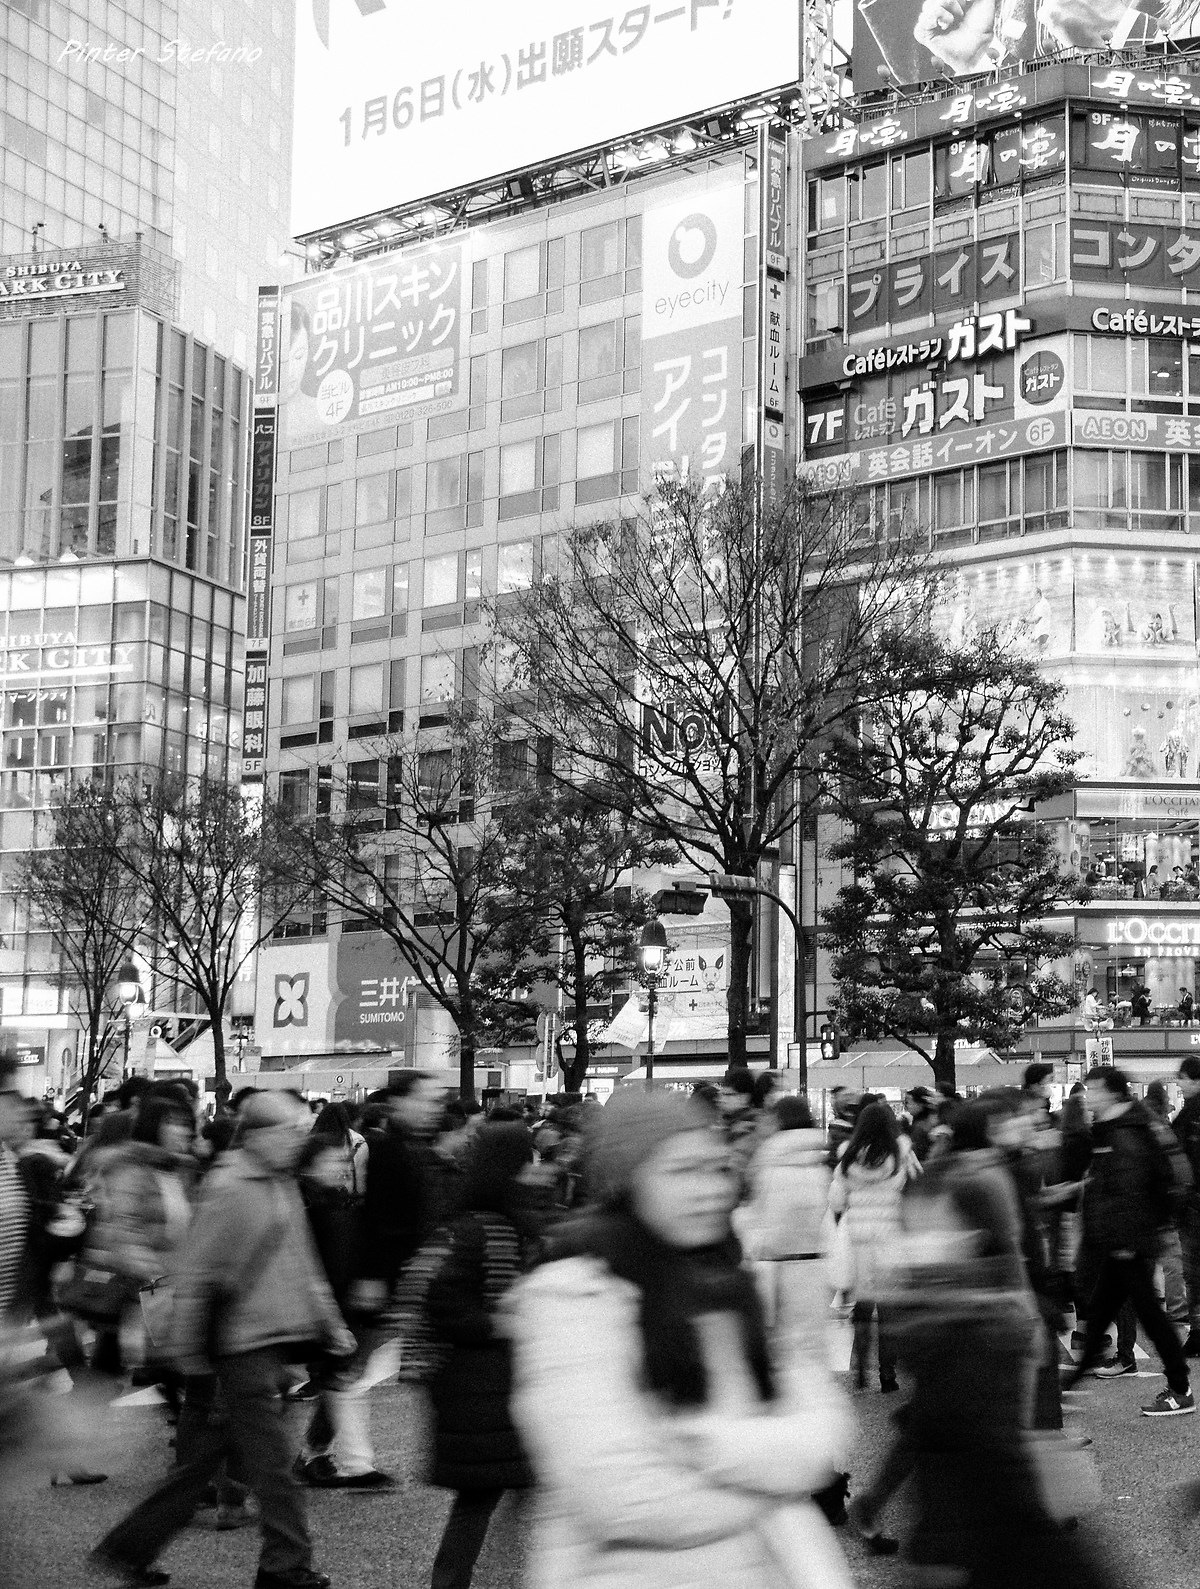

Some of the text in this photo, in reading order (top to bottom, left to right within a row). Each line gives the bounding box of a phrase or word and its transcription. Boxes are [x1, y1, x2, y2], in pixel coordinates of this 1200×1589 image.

[1092, 113, 1111, 125] 9F
[950, 141, 966, 155] 9F
[6, 261, 82, 278] SHIBUYA
[770, 254, 781, 265] 9F
[54, 269, 123, 291] CITY
[850, 244, 1020, 318] プライス
[313, 262, 457, 336] 品川スキン
[655, 280, 730, 318] eyecity
[313, 303, 456, 377] クリニック
[947, 309, 1031, 362] ガスト
[259, 312, 275, 390] 東急リバブル
[769, 311, 781, 393] 献血ルーム
[1025, 372, 1061, 393] ガスト
[325, 402, 344, 418] 4F
[769, 397, 780, 407] 6F
[854, 397, 897, 425] Café
[901, 374, 1004, 438] ガスト
[807, 409, 844, 444] 7F
[1083, 417, 1149, 440] AEON
[868, 428, 1017, 479] 英会話イーオン
[1029, 421, 1051, 441] 6F
[253, 515, 269, 525] 8F
[253, 539, 268, 592] 外貨両替
[251, 639, 264, 648] 7F
[47, 645, 135, 670] CITY
[245, 664, 265, 753] 加藤眼科
[245, 760, 261, 771] 5F
[1167, 807, 1189, 816] Café
[1134, 946, 1151, 957] EN
[663, 958, 696, 972] チ公前
[659, 975, 699, 988] 血ルーム
[359, 1011, 405, 1024] SUMITOMO
